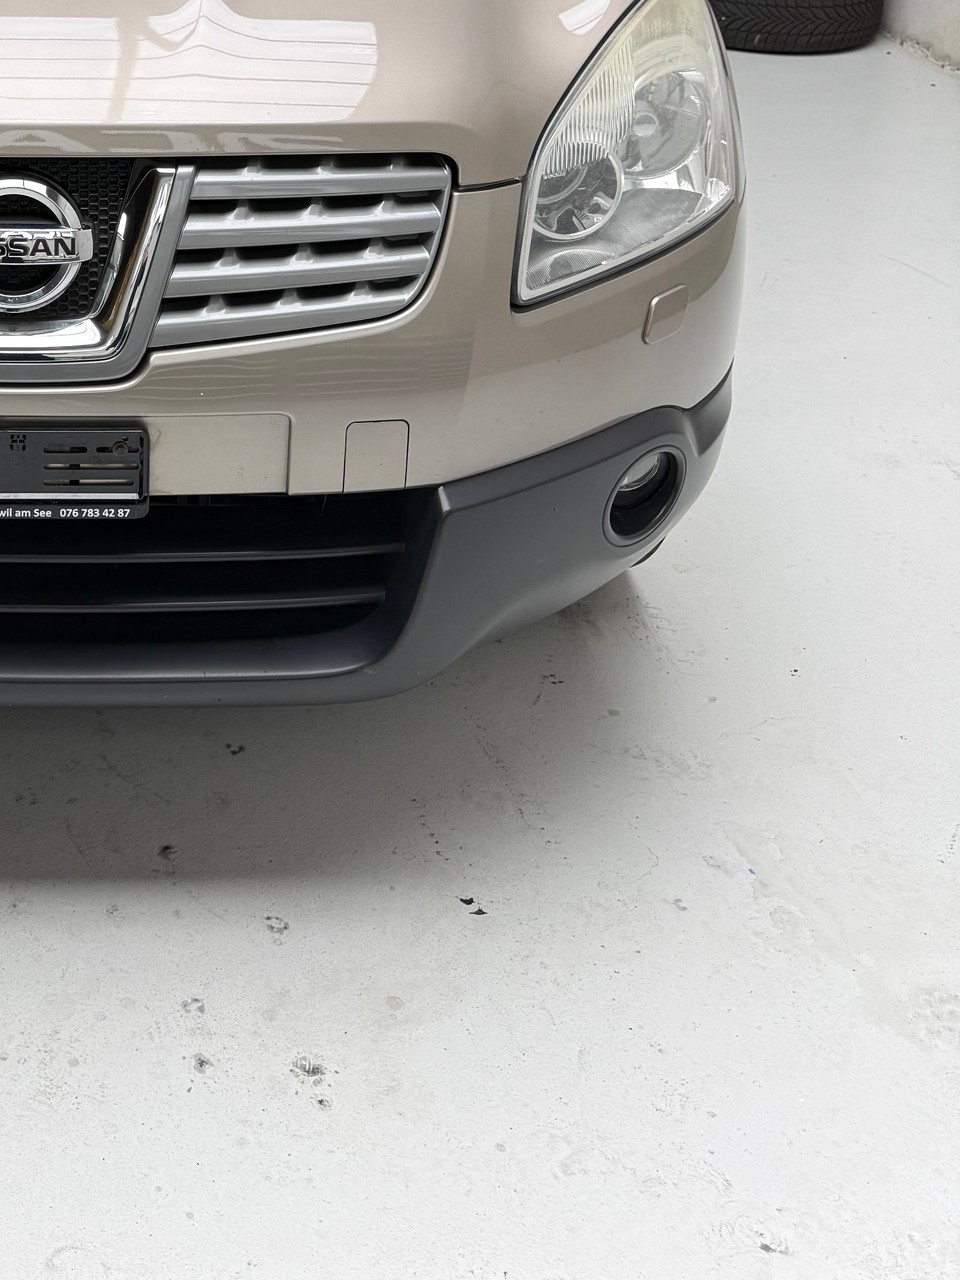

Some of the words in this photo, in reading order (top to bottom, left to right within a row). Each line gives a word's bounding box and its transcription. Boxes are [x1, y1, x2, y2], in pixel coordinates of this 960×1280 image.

[33, 508, 52, 517] See
[60, 508, 78, 517] 076
[81, 508, 100, 517] 783
[102, 508, 115, 517] 42
[118, 508, 130, 517] 87
